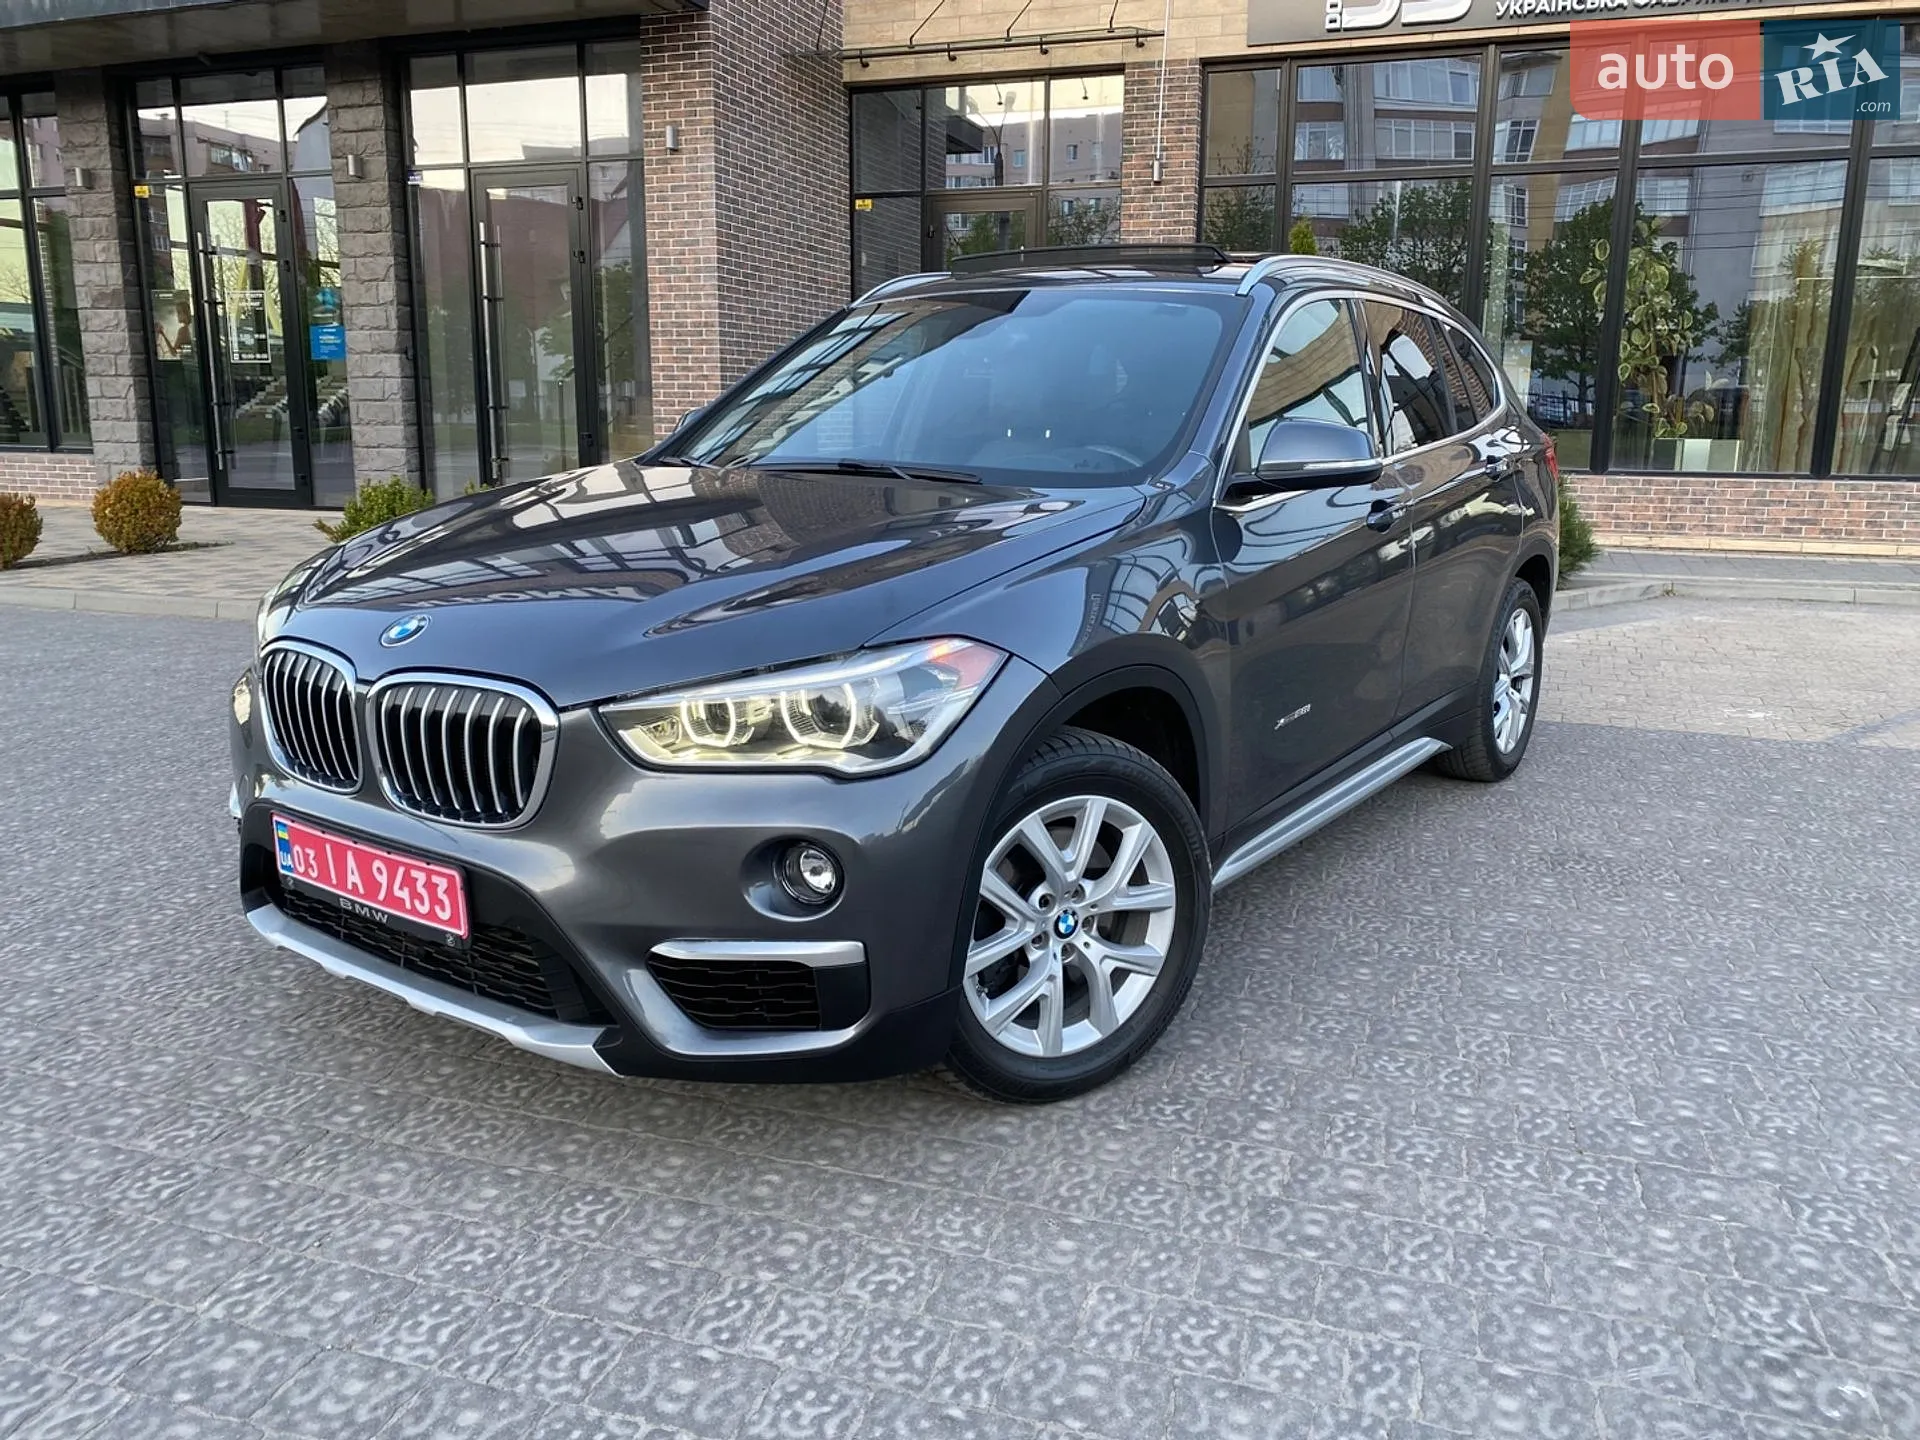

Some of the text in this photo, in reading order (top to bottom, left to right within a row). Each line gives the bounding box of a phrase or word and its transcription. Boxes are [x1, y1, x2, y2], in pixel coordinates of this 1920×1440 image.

[279, 851, 294, 869] UA
[371, 859, 453, 921] 9433
[339, 897, 389, 924] BMW
